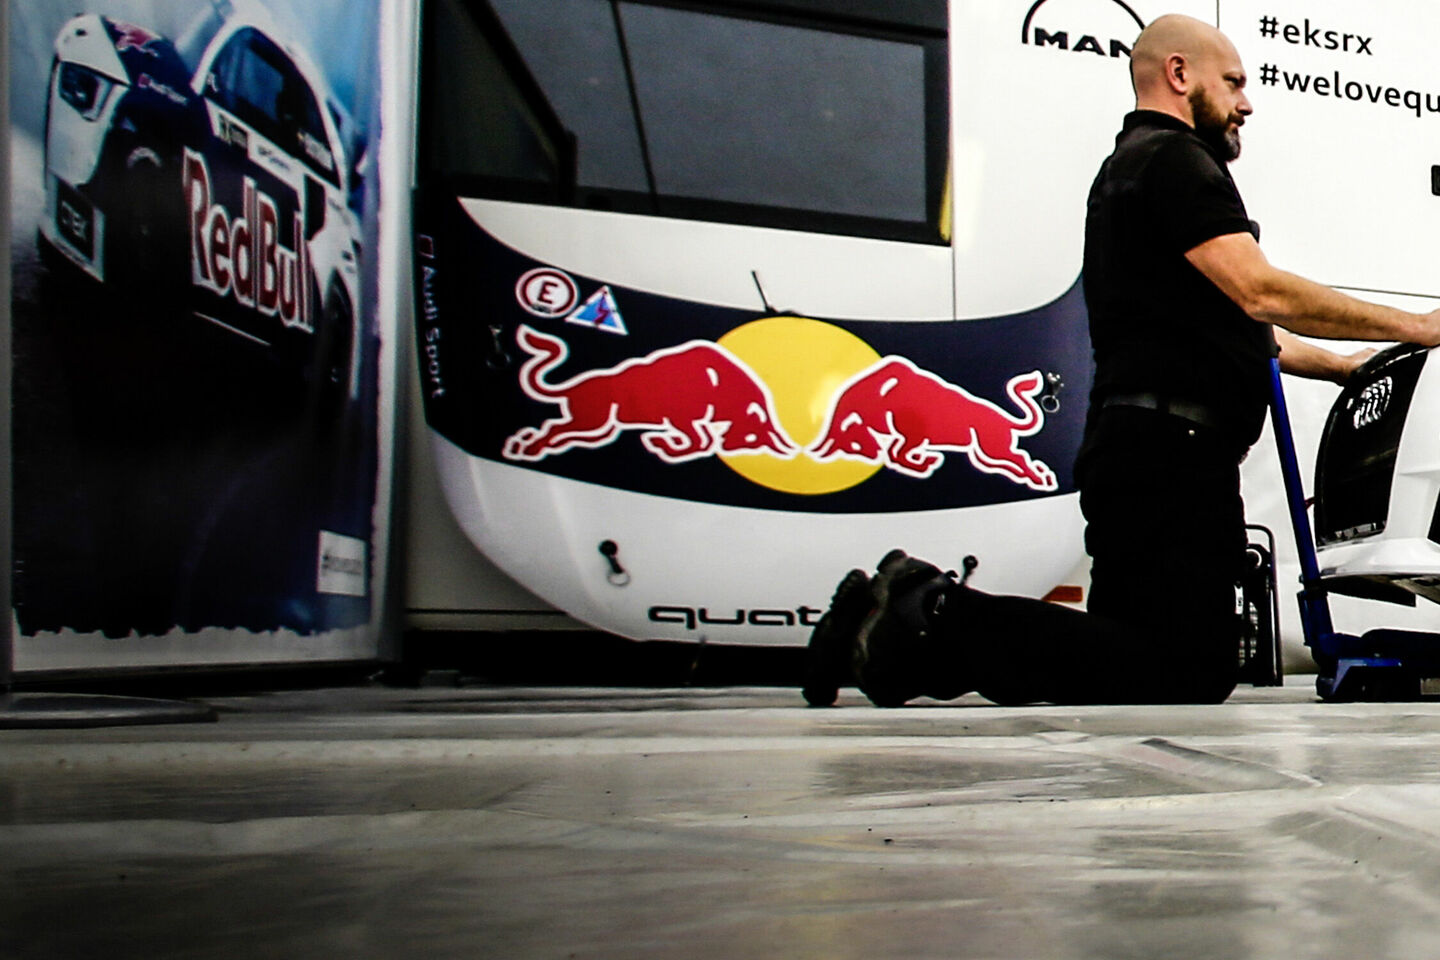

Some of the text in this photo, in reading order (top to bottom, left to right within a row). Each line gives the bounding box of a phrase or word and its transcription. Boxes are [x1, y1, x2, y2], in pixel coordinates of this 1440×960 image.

[1259, 14, 1373, 56] #eksrx
[183, 145, 314, 334] Red Bull
[425, 327, 446, 399] Sport
